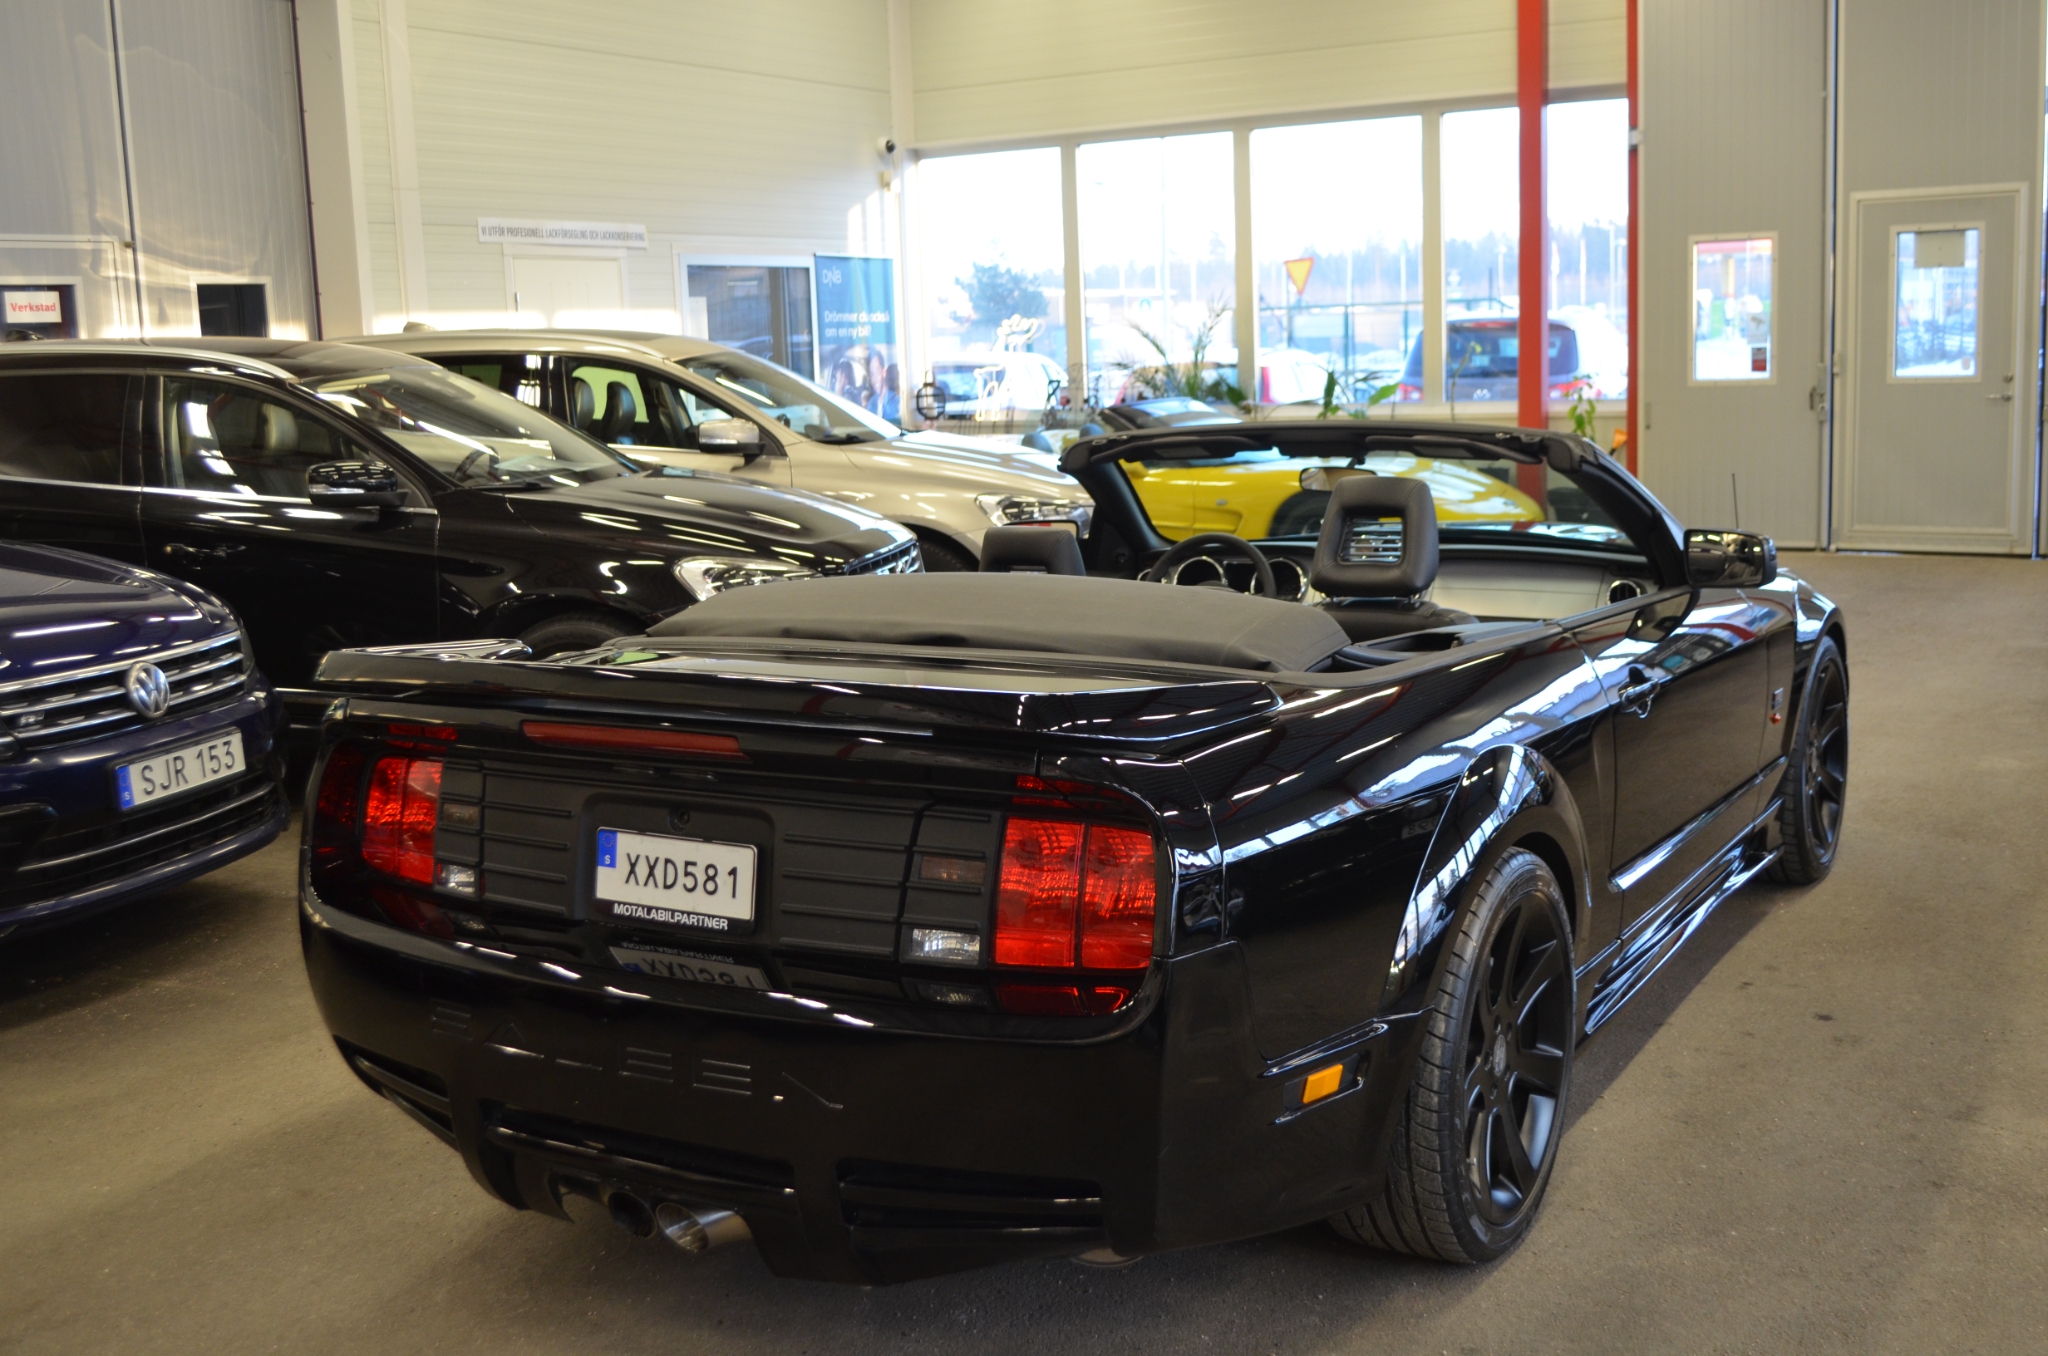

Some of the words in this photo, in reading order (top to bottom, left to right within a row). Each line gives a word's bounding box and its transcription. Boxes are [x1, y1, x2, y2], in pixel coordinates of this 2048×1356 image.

[488, 224, 506, 237] UTFÖR
[822, 265, 842, 287] DNB
[10, 302, 57, 312] Verkstad
[824, 310, 858, 323] Drömmer
[859, 310, 868, 323] du
[825, 327, 837, 337] om
[838, 327, 848, 337] en
[848, 328, 858, 340] ny
[141, 754, 189, 795] SJR
[196, 740, 235, 778] 153
[123, 791, 131, 800] S
[604, 854, 611, 864] S
[624, 852, 738, 899] XXD581
[613, 903, 728, 930] MOTALABILPARTNER
